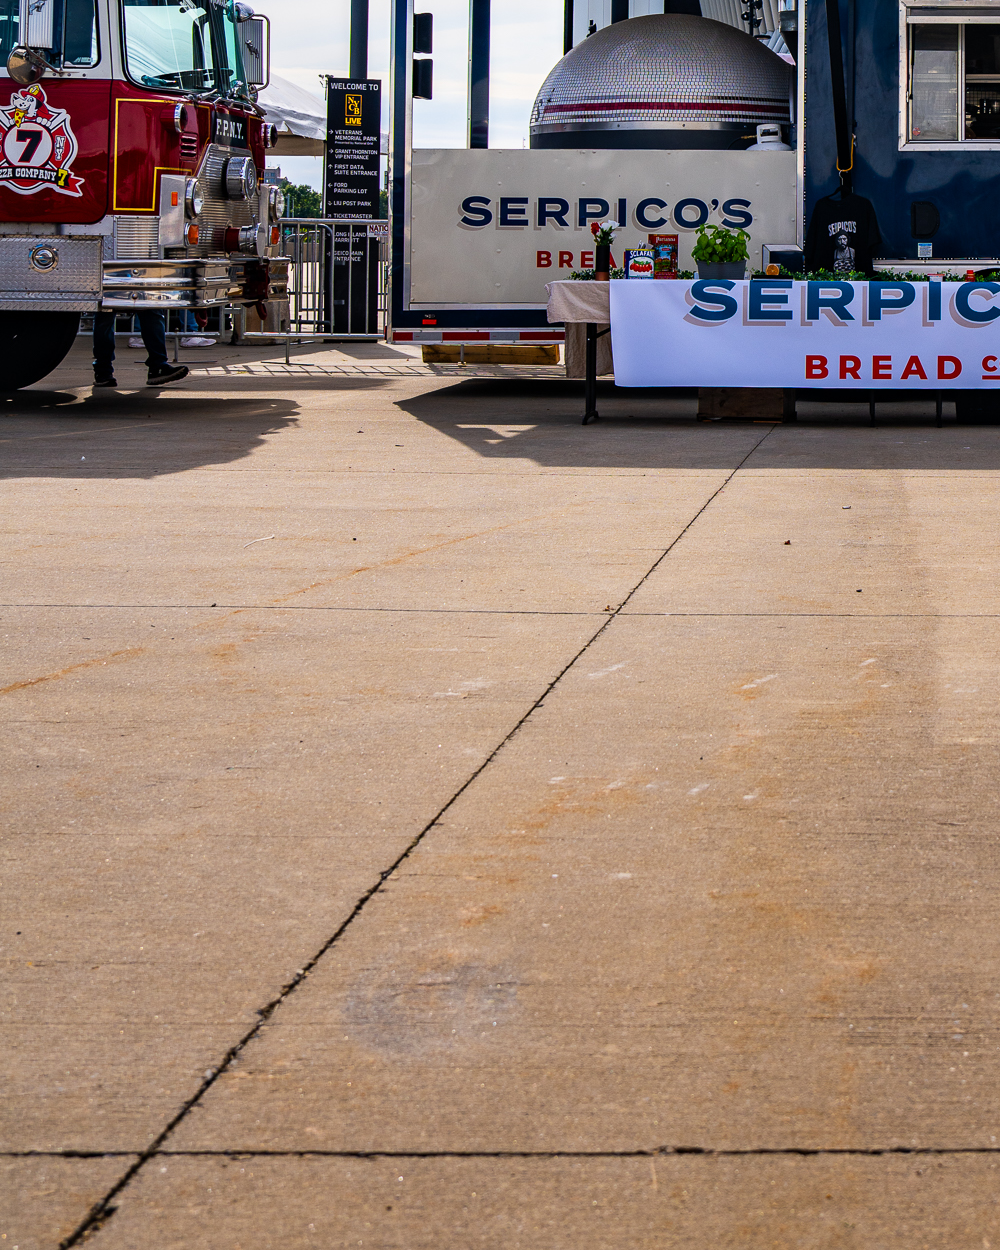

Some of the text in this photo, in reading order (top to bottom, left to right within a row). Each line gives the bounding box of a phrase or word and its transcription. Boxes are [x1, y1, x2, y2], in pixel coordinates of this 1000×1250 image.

[330, 82, 379, 91] WELCOME TO
[216, 118, 244, 140] F.P.N.Y.
[345, 117, 362, 125] LIVE
[16, 129, 43, 163] 7
[15, 167, 57, 181] COMPANY
[57, 168, 68, 187] 7
[457, 195, 754, 231] SERPICO'S
[805, 354, 963, 380] BREAD
